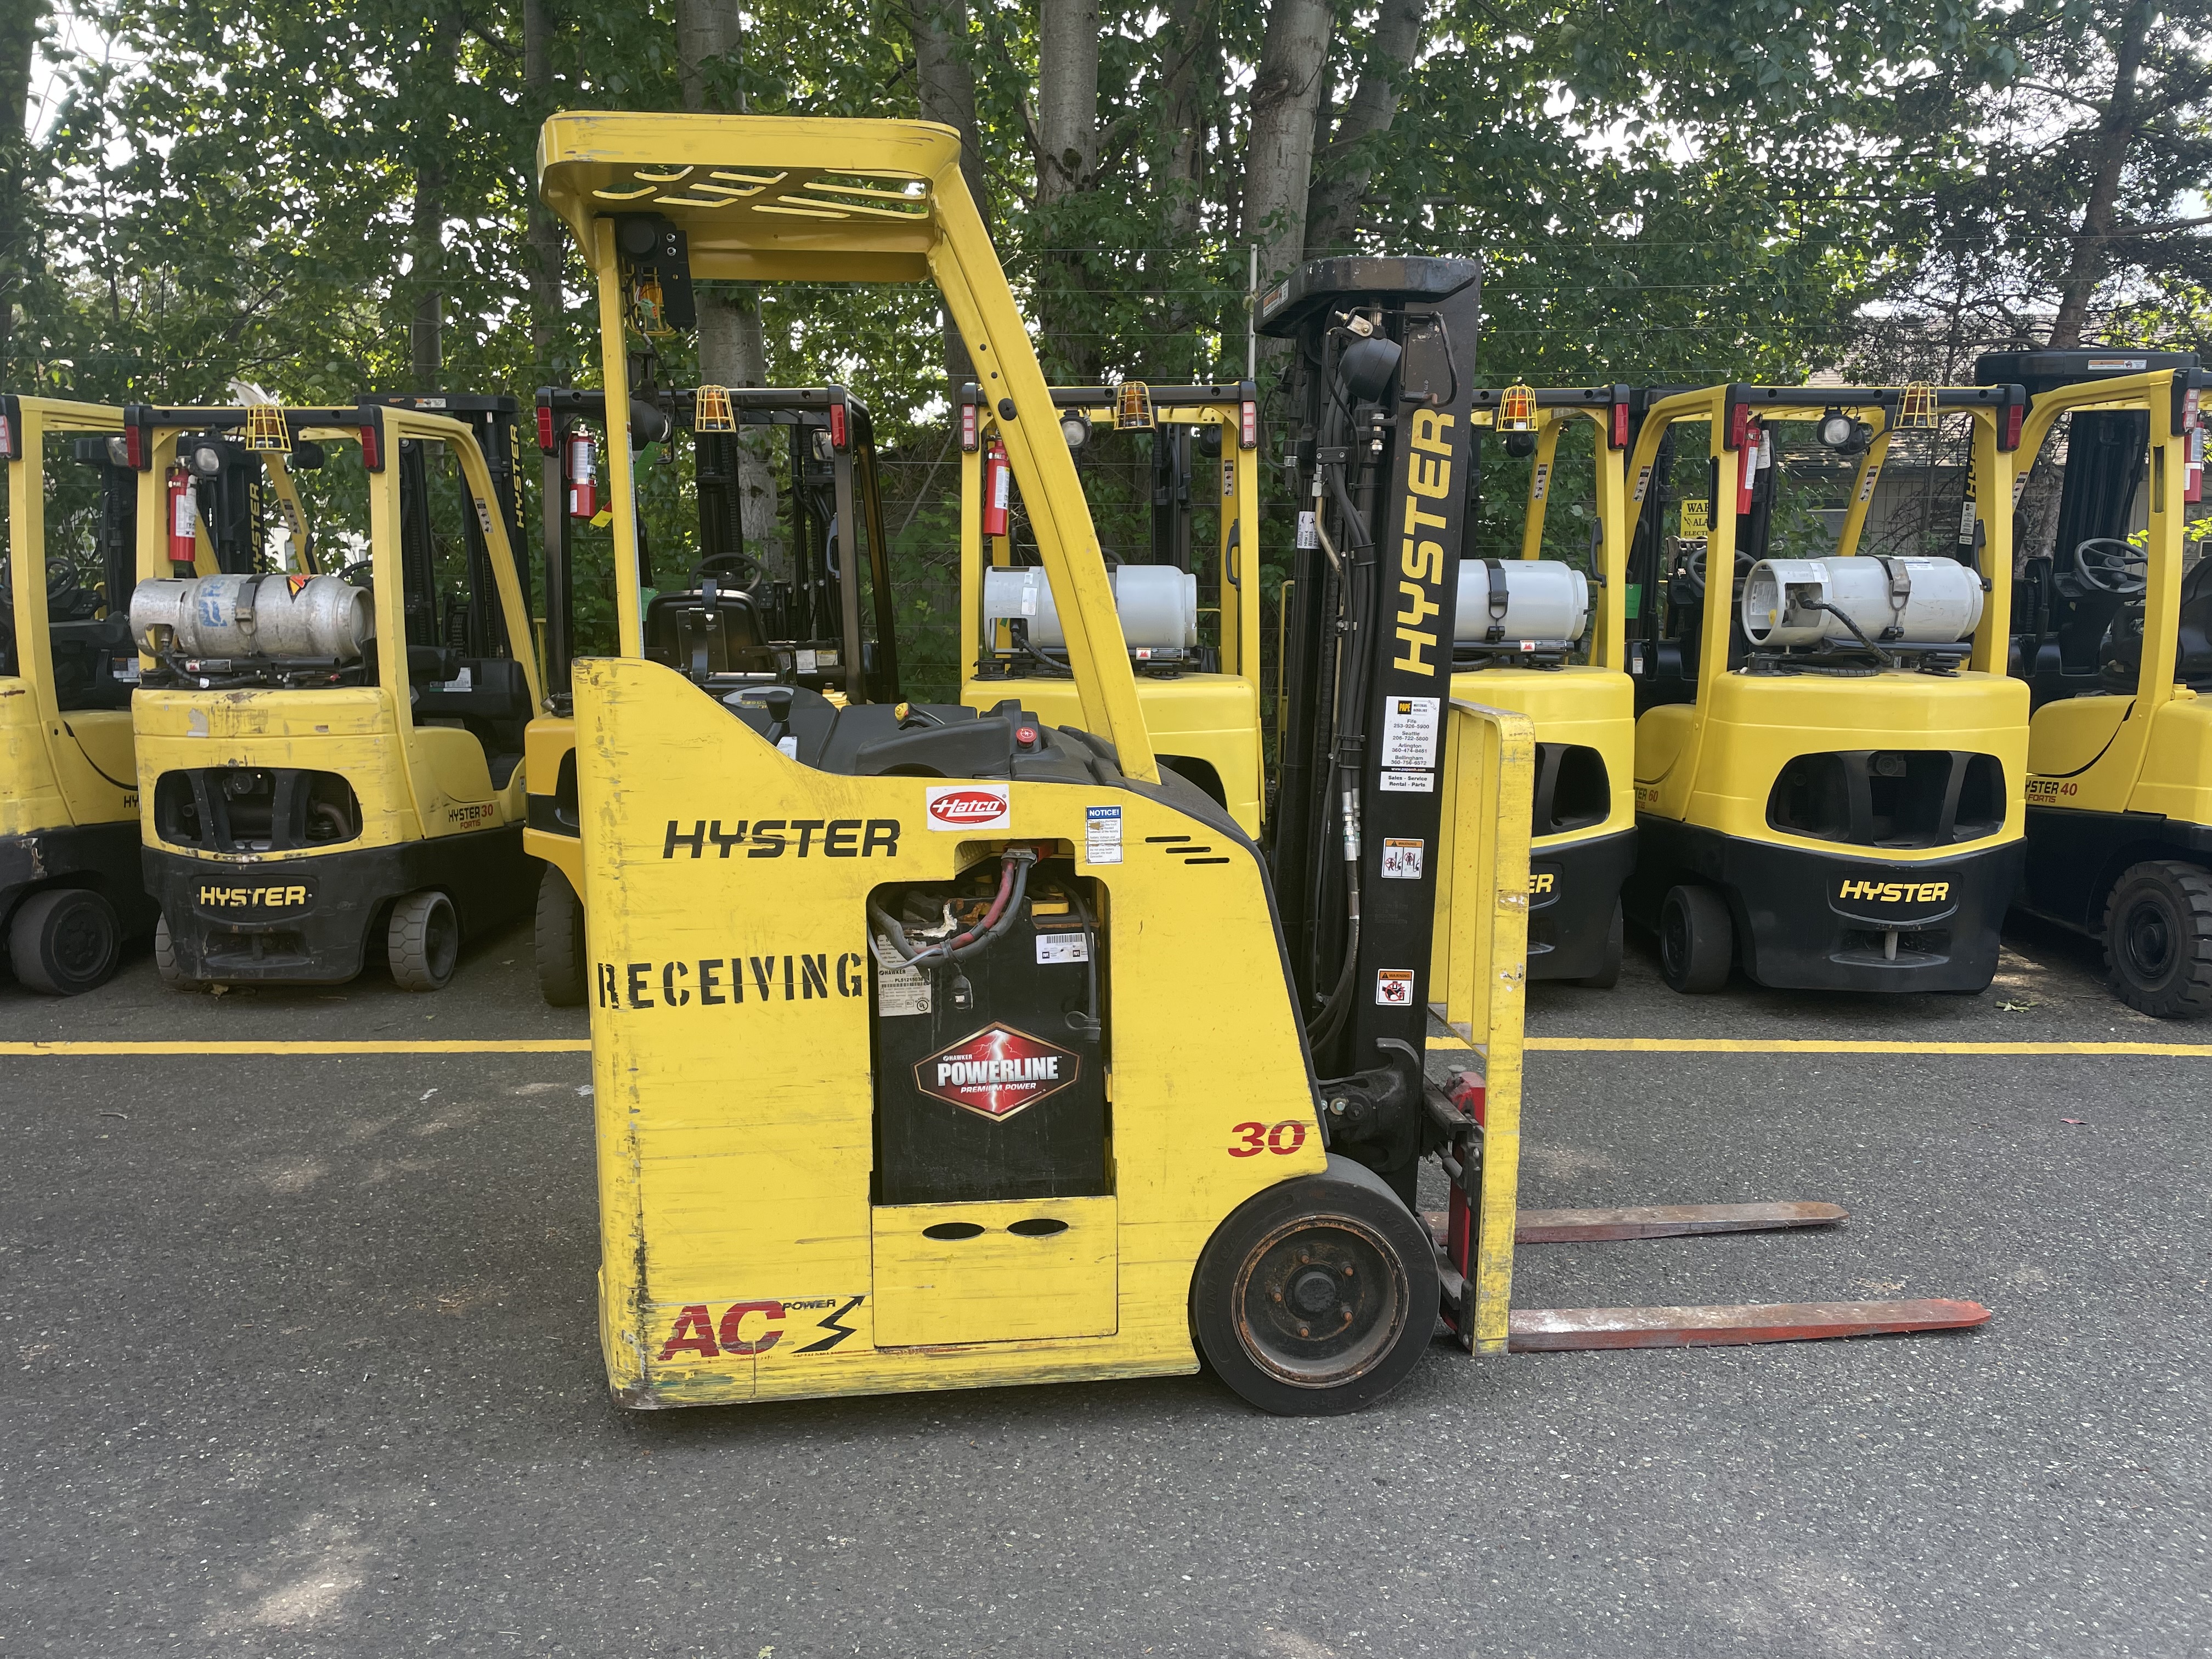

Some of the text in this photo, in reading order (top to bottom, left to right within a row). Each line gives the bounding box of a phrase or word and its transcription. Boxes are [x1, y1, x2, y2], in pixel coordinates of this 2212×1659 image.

[509, 424, 524, 528] HYSTER
[1393, 409, 1455, 676] HYSTER
[1649, 790, 1658, 802] 60
[2028, 794, 2056, 803] FORTIS
[2061, 783, 2078, 796] 40
[448, 804, 493, 822] HYSTER 30
[933, 799, 1002, 817] Hatco
[460, 819, 481, 830] FORTIS
[663, 819, 902, 859] HYSTER
[200, 885, 306, 908] HYSTER
[1839, 879, 1949, 902] HYSTER
[597, 952, 863, 1009] RECEIVING
[937, 1056, 1059, 1086] POWERLINE
[960, 1082, 1036, 1094] PREMIUM POWER
[1228, 1120, 1307, 1158] 30
[658, 1298, 837, 1362] AC POWER
